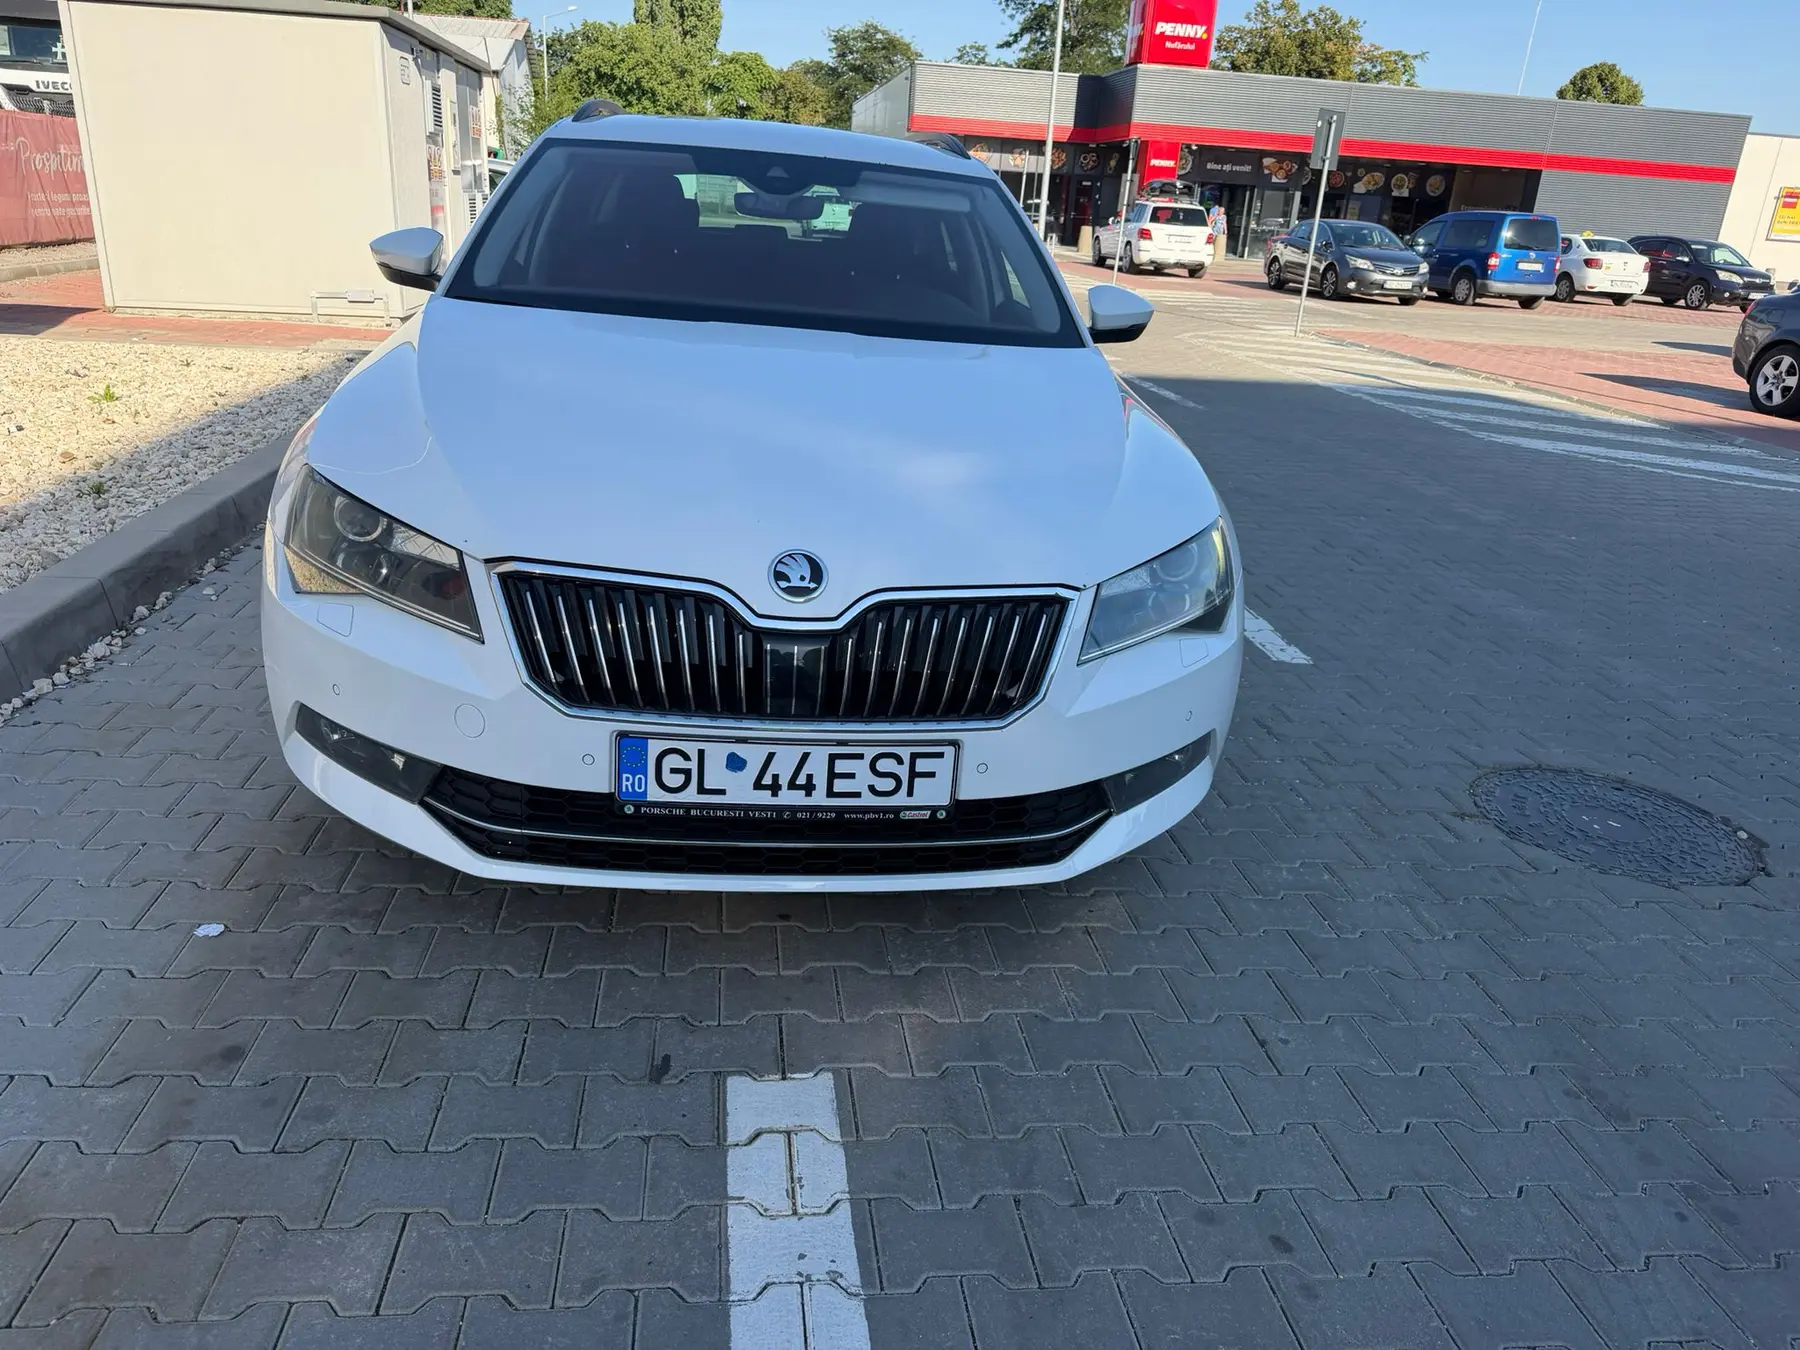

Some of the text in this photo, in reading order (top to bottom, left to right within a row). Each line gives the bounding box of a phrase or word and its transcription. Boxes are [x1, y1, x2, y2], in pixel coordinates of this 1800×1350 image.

[35, 80, 73, 91] IVEC
[1206, 161, 1222, 170] Bine
[622, 773, 646, 794] RO
[654, 747, 728, 796] GL
[640, 806, 686, 816] PORSCHE
[690, 808, 744, 817] BUCURESTI
